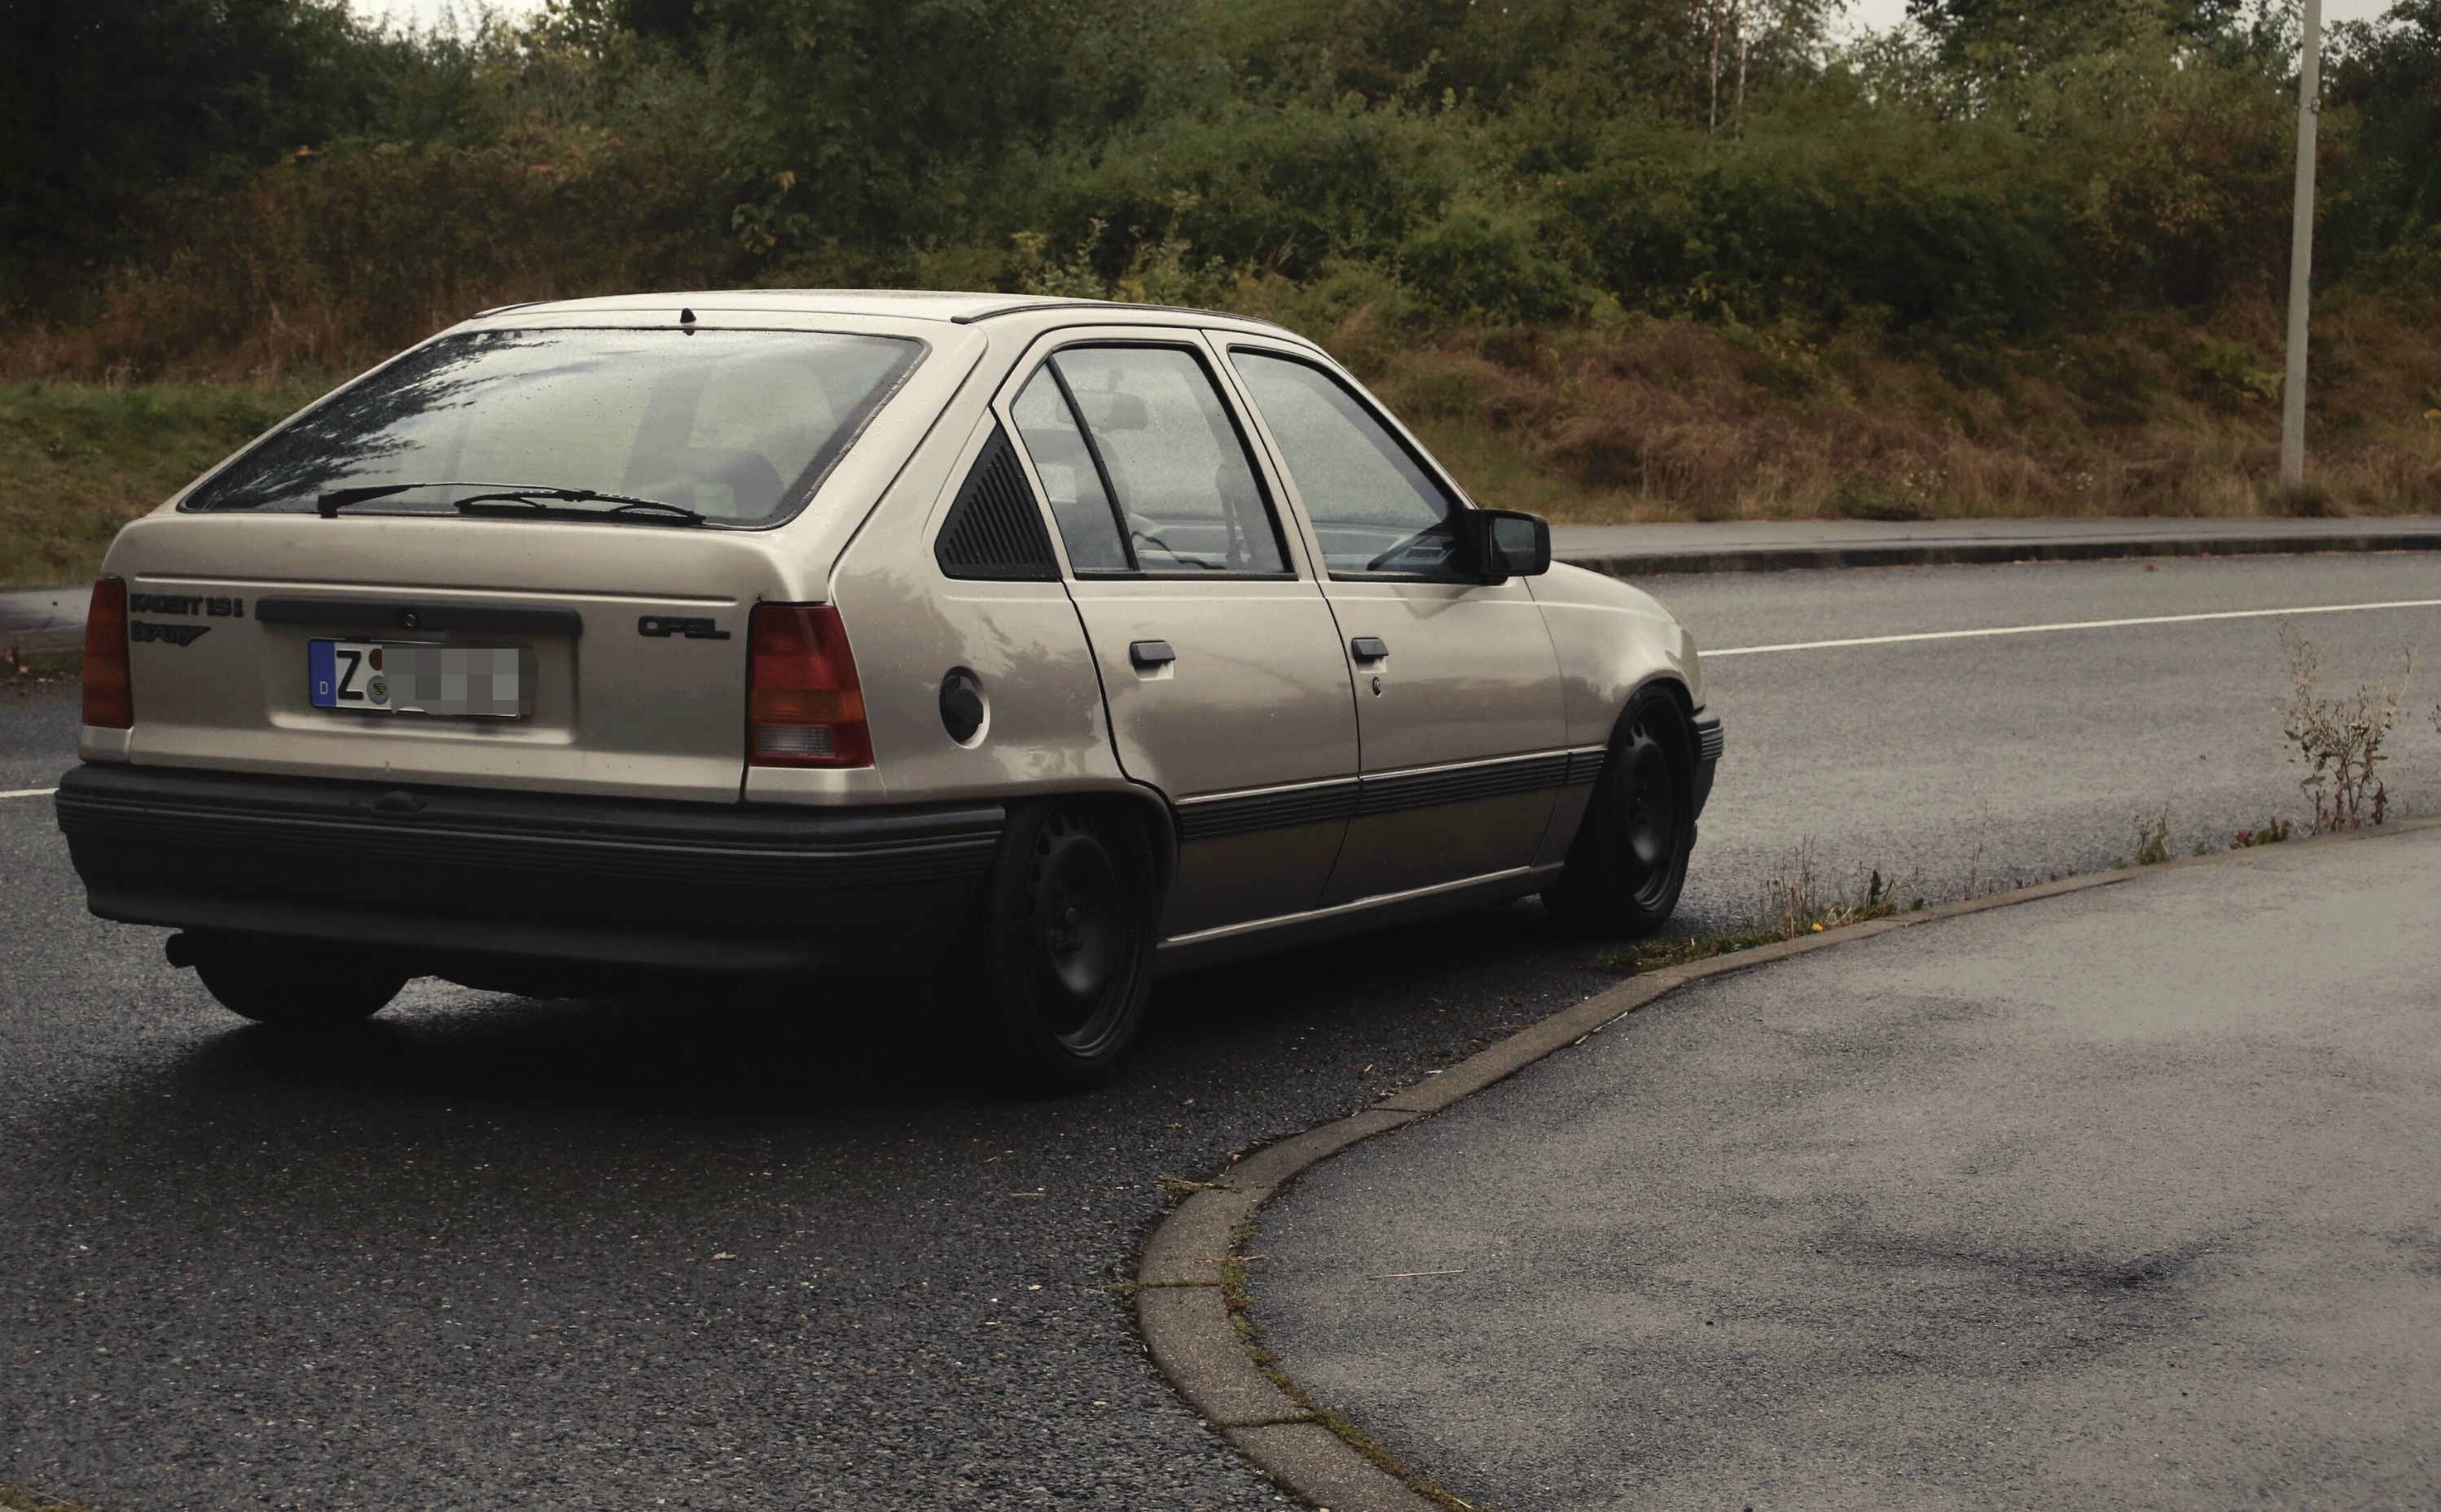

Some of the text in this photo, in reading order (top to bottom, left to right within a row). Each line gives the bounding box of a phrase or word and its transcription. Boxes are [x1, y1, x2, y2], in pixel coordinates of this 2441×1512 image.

[130, 594, 203, 616] KADETT
[638, 616, 731, 640] OPEL
[319, 681, 328, 695] D
[336, 649, 364, 700] Z
